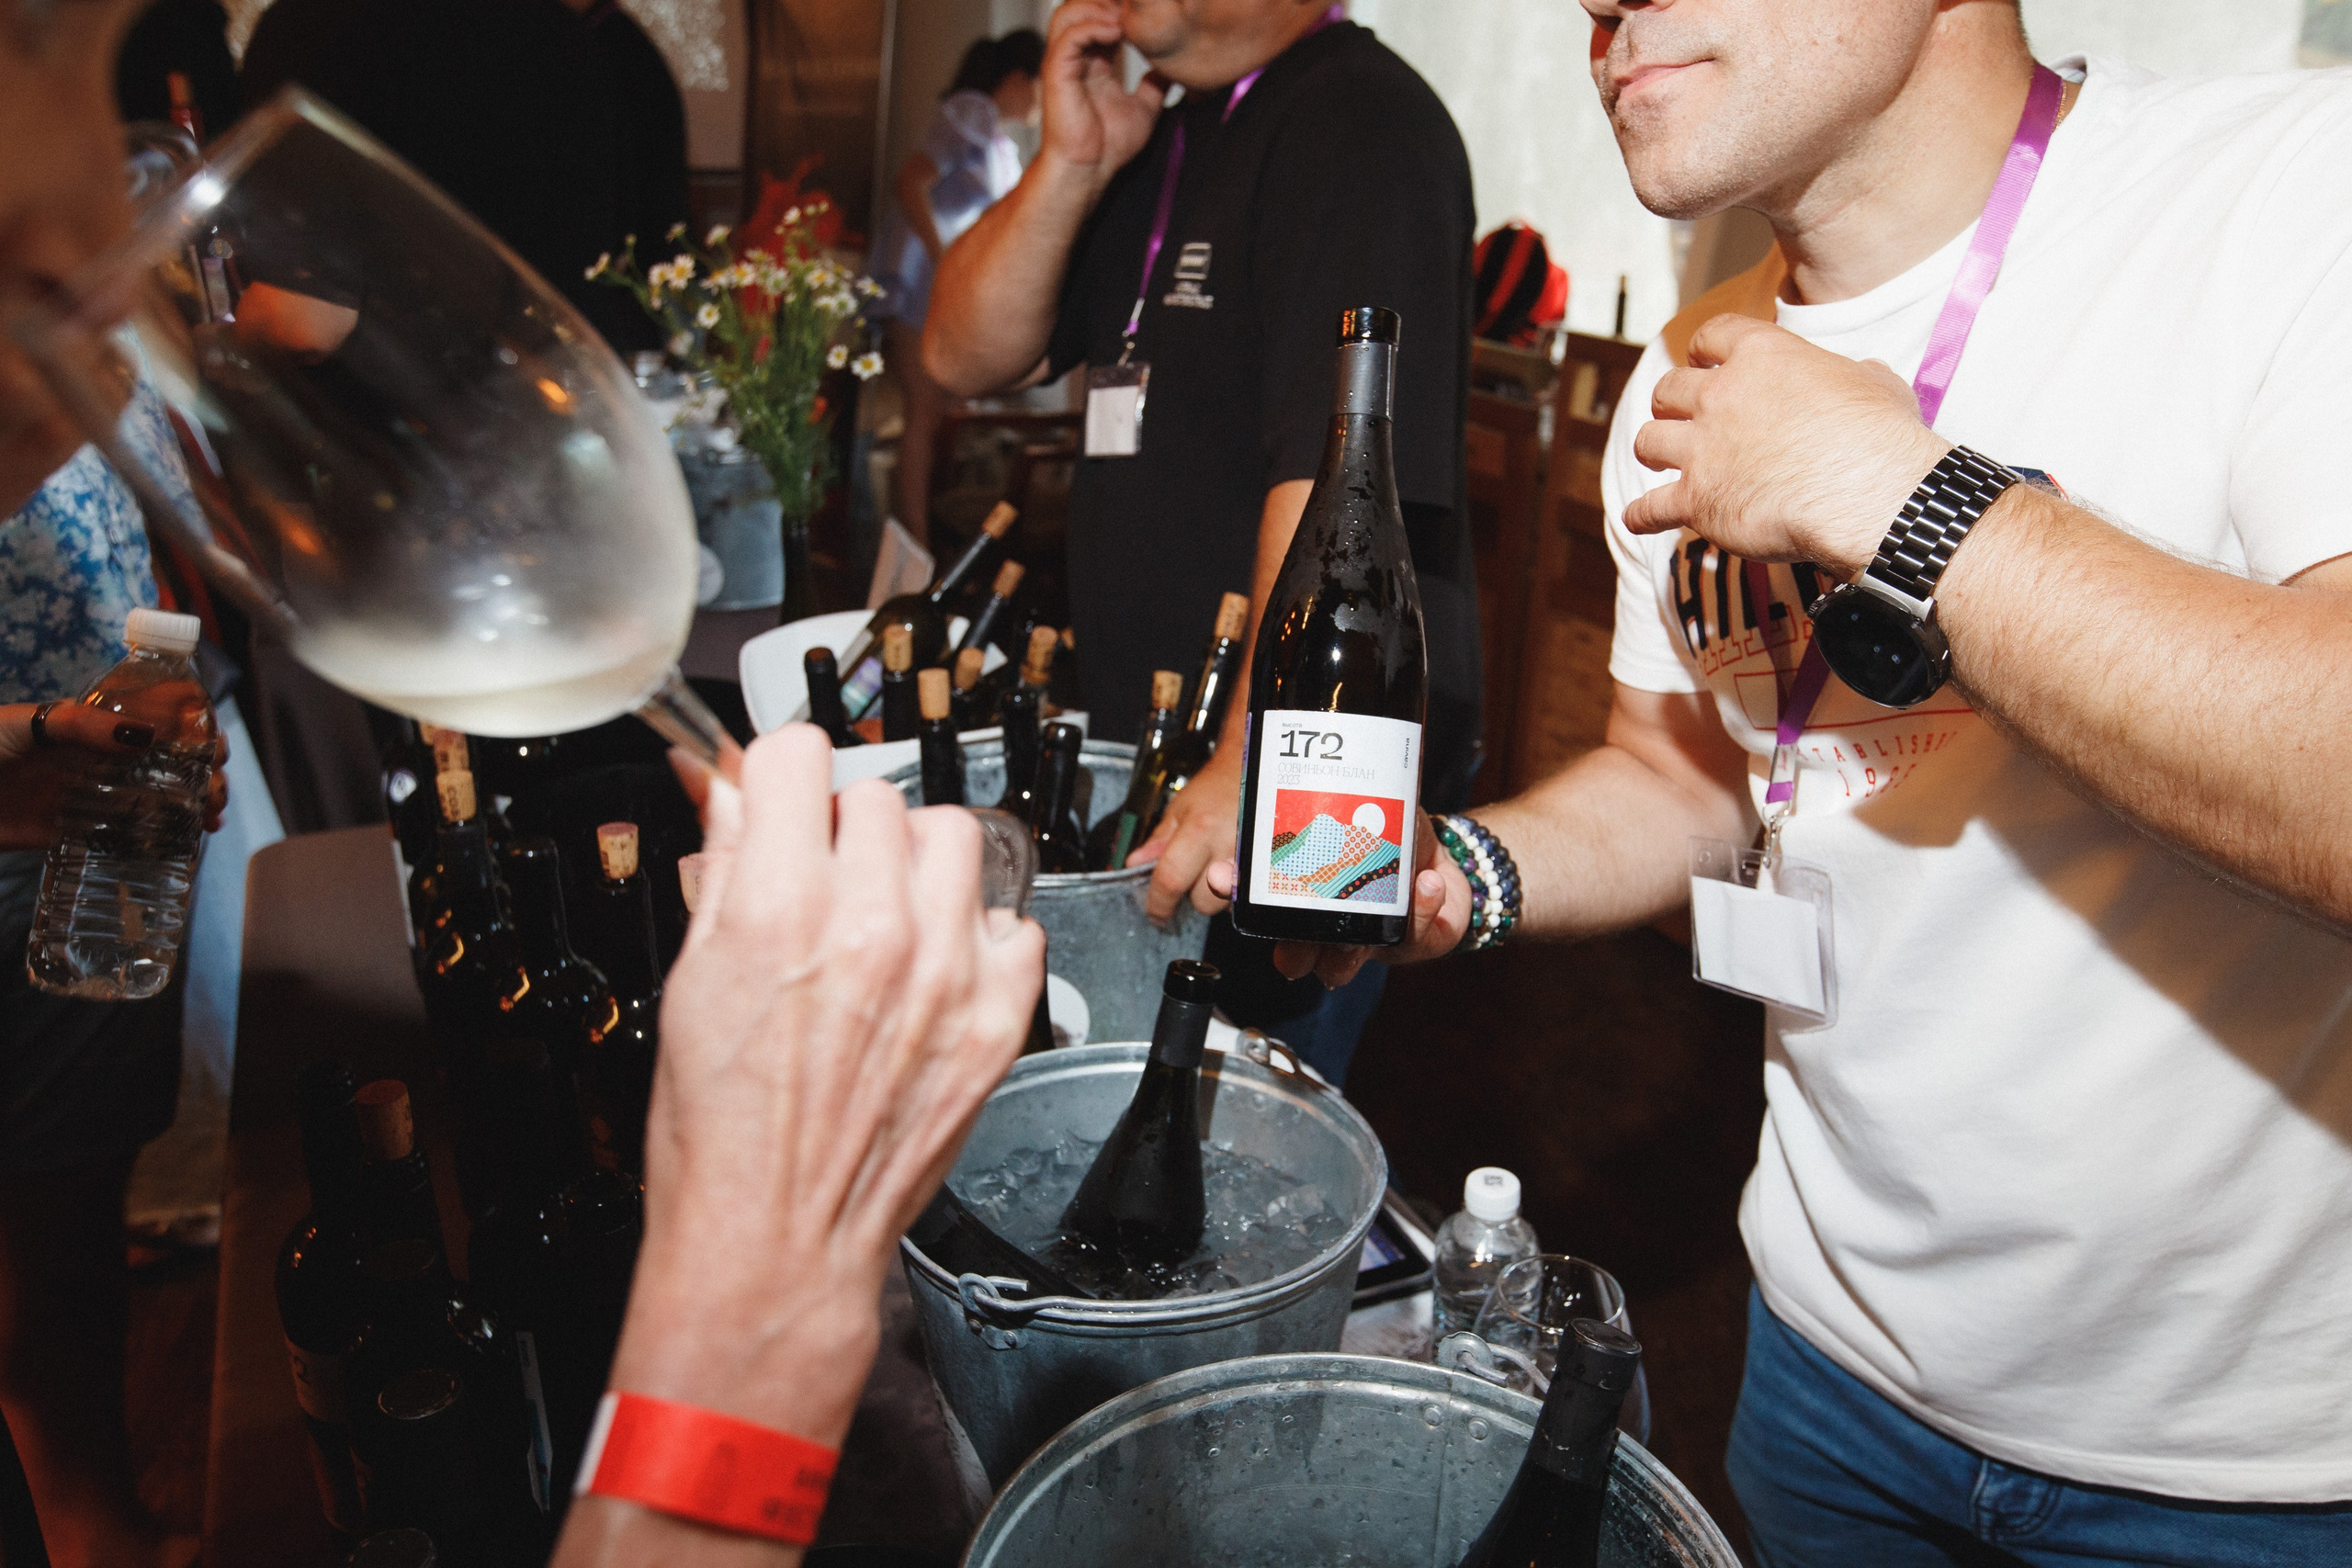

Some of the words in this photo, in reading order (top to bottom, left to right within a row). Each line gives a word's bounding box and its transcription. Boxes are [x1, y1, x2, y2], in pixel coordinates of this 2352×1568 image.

[1280, 730, 1343, 761] 172
[1277, 761, 1340, 776] СОВИНЬОН
[1343, 767, 1375, 780] БЛАН
[1277, 773, 1301, 785] 2023
